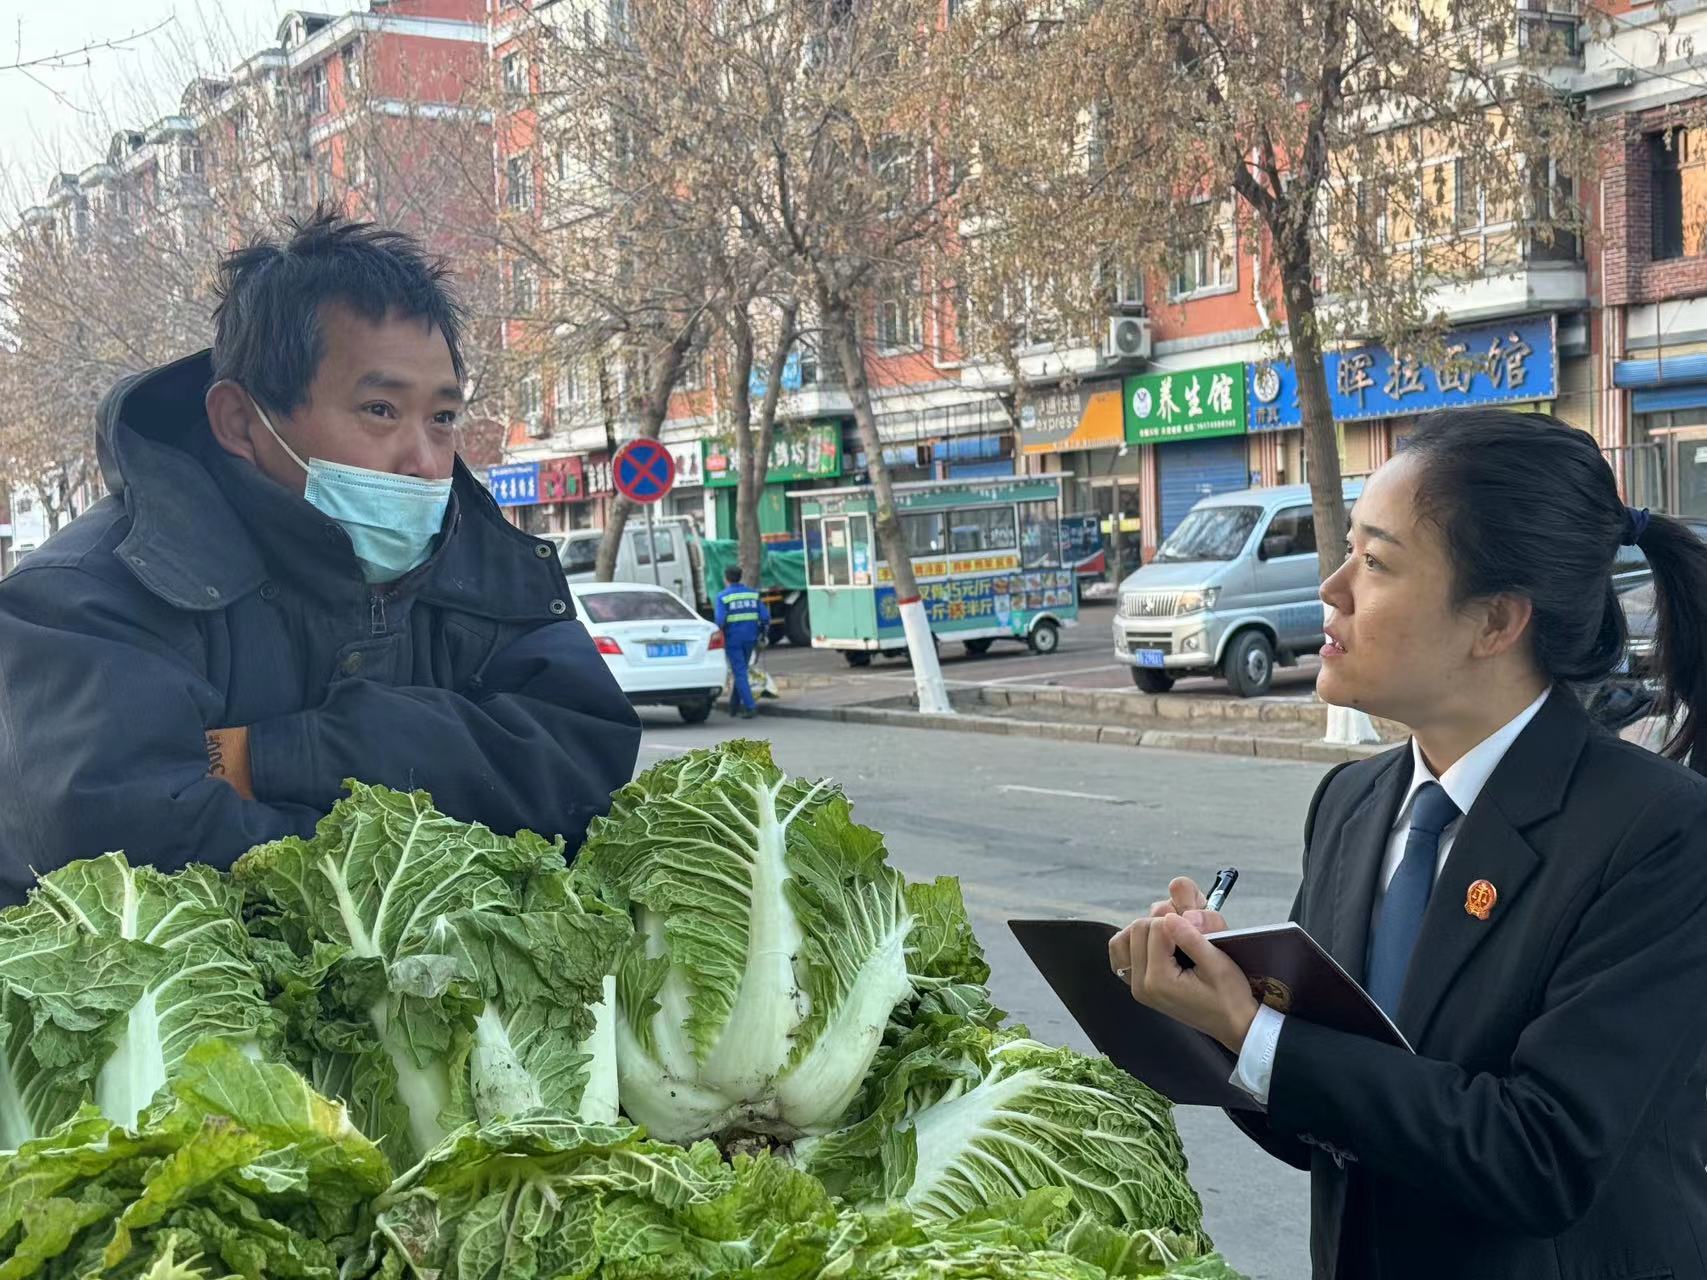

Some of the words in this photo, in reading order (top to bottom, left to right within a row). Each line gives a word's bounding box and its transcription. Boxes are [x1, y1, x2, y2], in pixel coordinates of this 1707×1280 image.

[1291, 331, 1532, 409] 晖拉面馆
[1035, 415, 1079, 433] express
[1156, 373, 1234, 424] 养生馆
